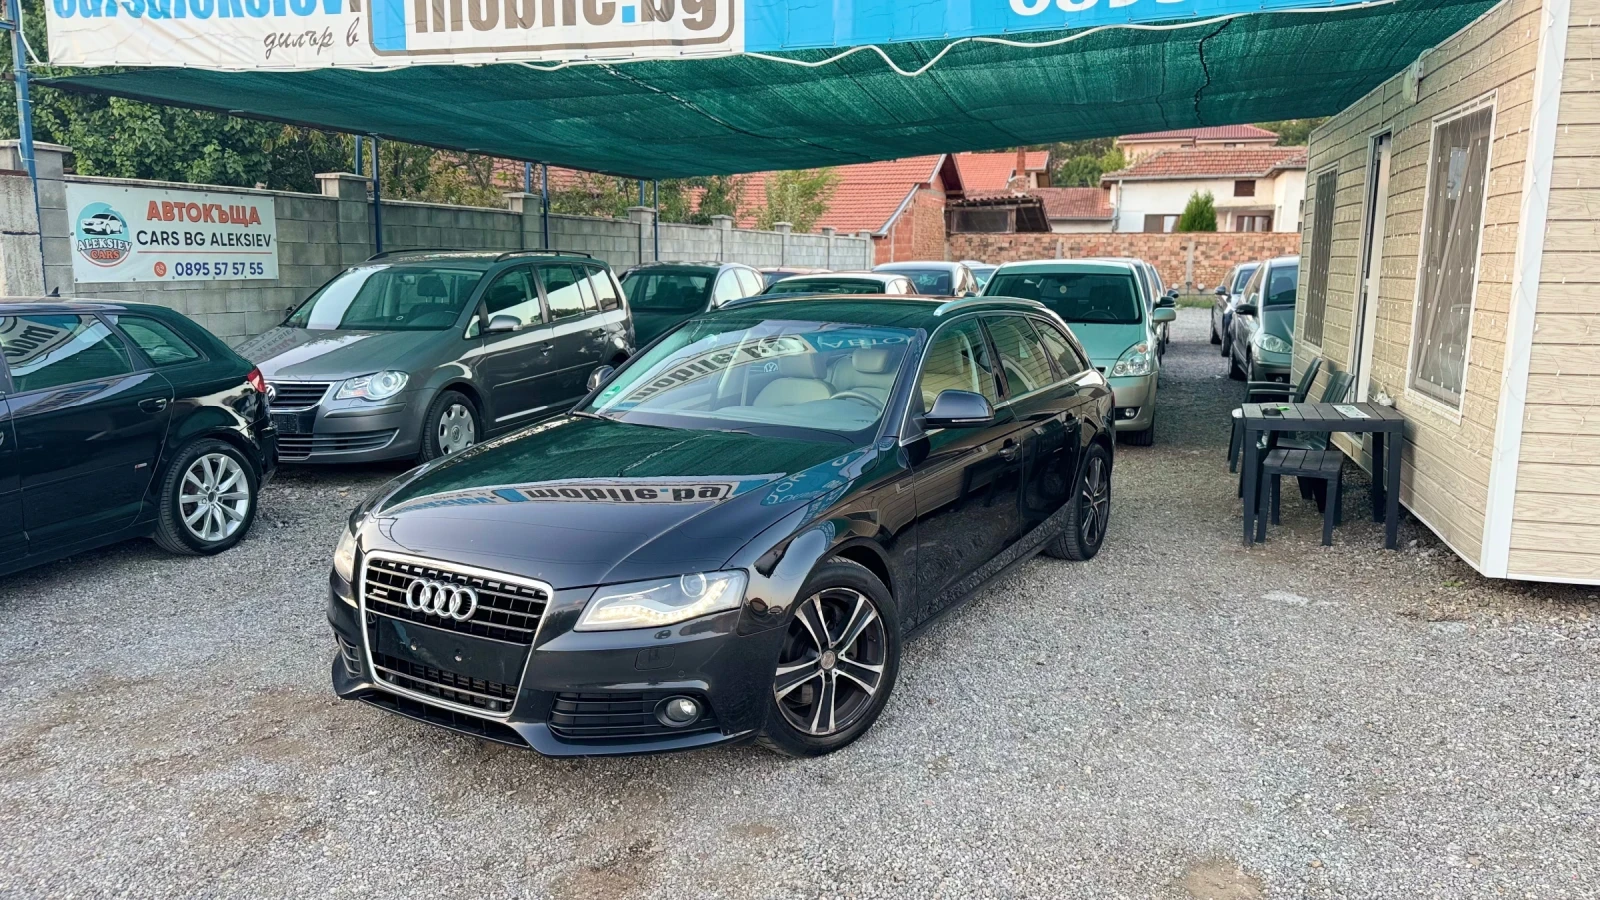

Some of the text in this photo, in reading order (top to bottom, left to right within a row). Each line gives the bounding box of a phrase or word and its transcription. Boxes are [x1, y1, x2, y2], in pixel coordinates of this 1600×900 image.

[263, 17, 360, 60] дилър в
[147, 200, 261, 227] АВТОКЪЩА
[77, 238, 133, 252] ALEKSIEV
[136, 230, 272, 247] CARS BG ALEKSIEV
[90, 249, 120, 260] CARS
[175, 262, 264, 276] 0895 57 57 55
